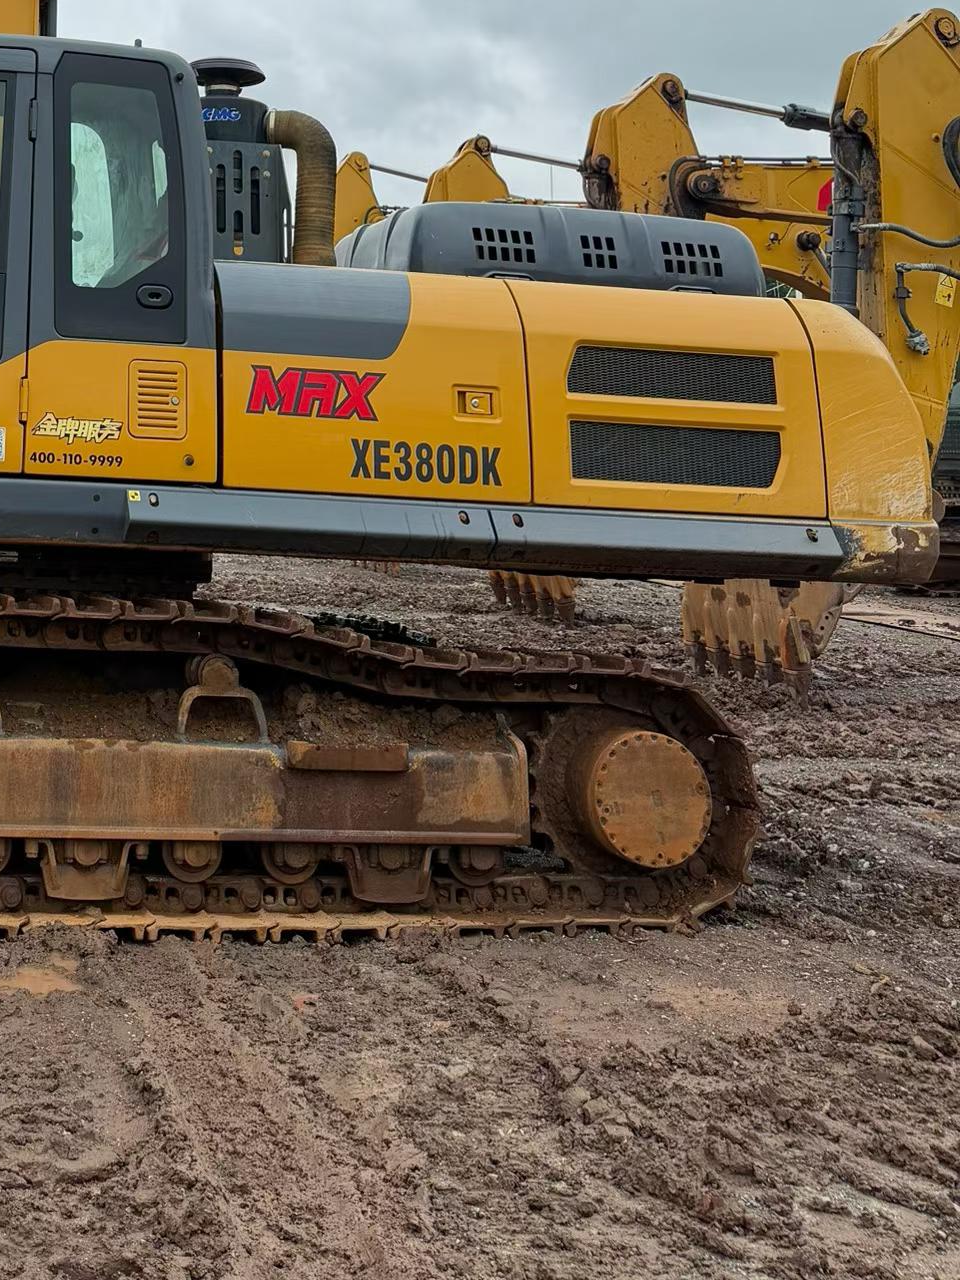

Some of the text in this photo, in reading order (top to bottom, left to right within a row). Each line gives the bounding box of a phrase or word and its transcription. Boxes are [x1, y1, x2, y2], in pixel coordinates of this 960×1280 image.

[201, 107, 241, 122] CMG
[246, 365, 386, 421] MAX
[32, 412, 123, 444] 金牌服务
[29, 451, 123, 467] 400-110-9999
[351, 438, 502, 487] XE380DK
